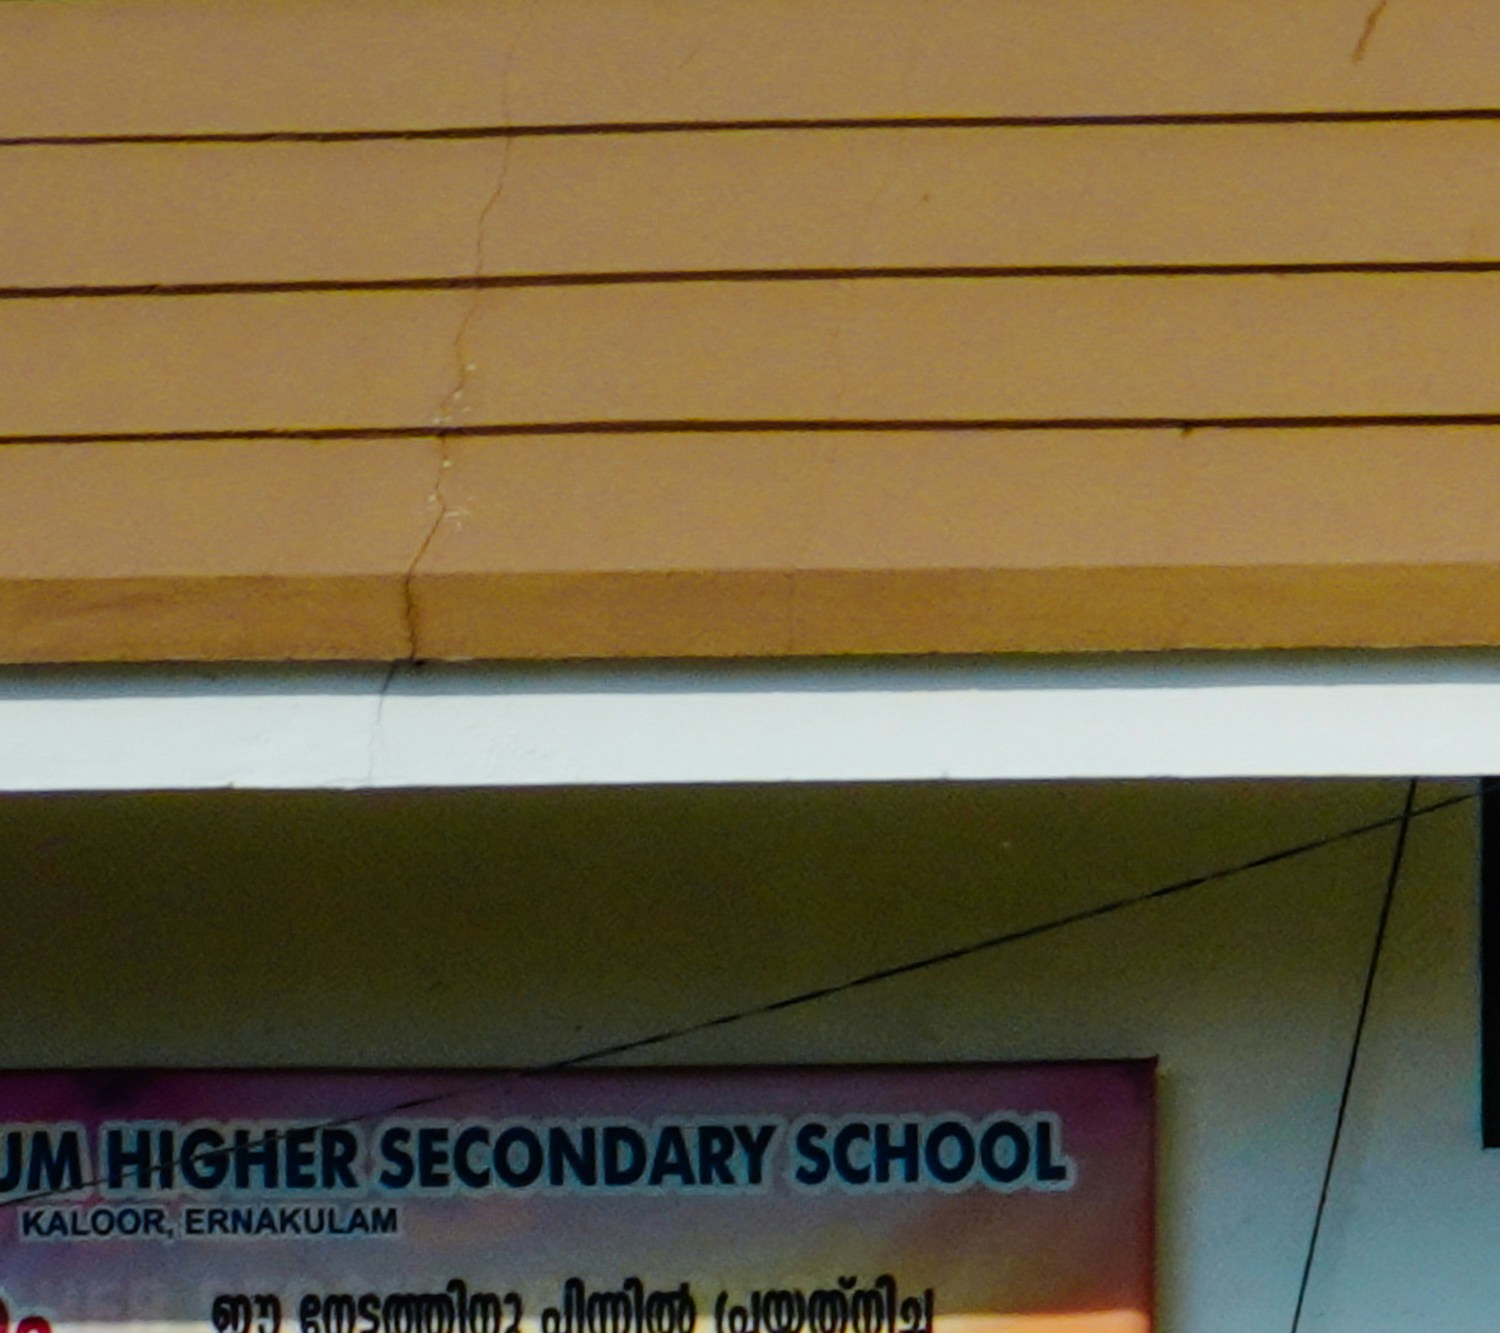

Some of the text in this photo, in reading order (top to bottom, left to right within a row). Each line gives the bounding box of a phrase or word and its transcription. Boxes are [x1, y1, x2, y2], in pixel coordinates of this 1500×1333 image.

[107, 1129, 358, 1189] HIGHER
[380, 1124, 778, 1189] SECONDARY
[795, 1120, 1066, 1185] SCHOOL
[22, 1207, 398, 1239] KALOOR, ERNAKULAM
